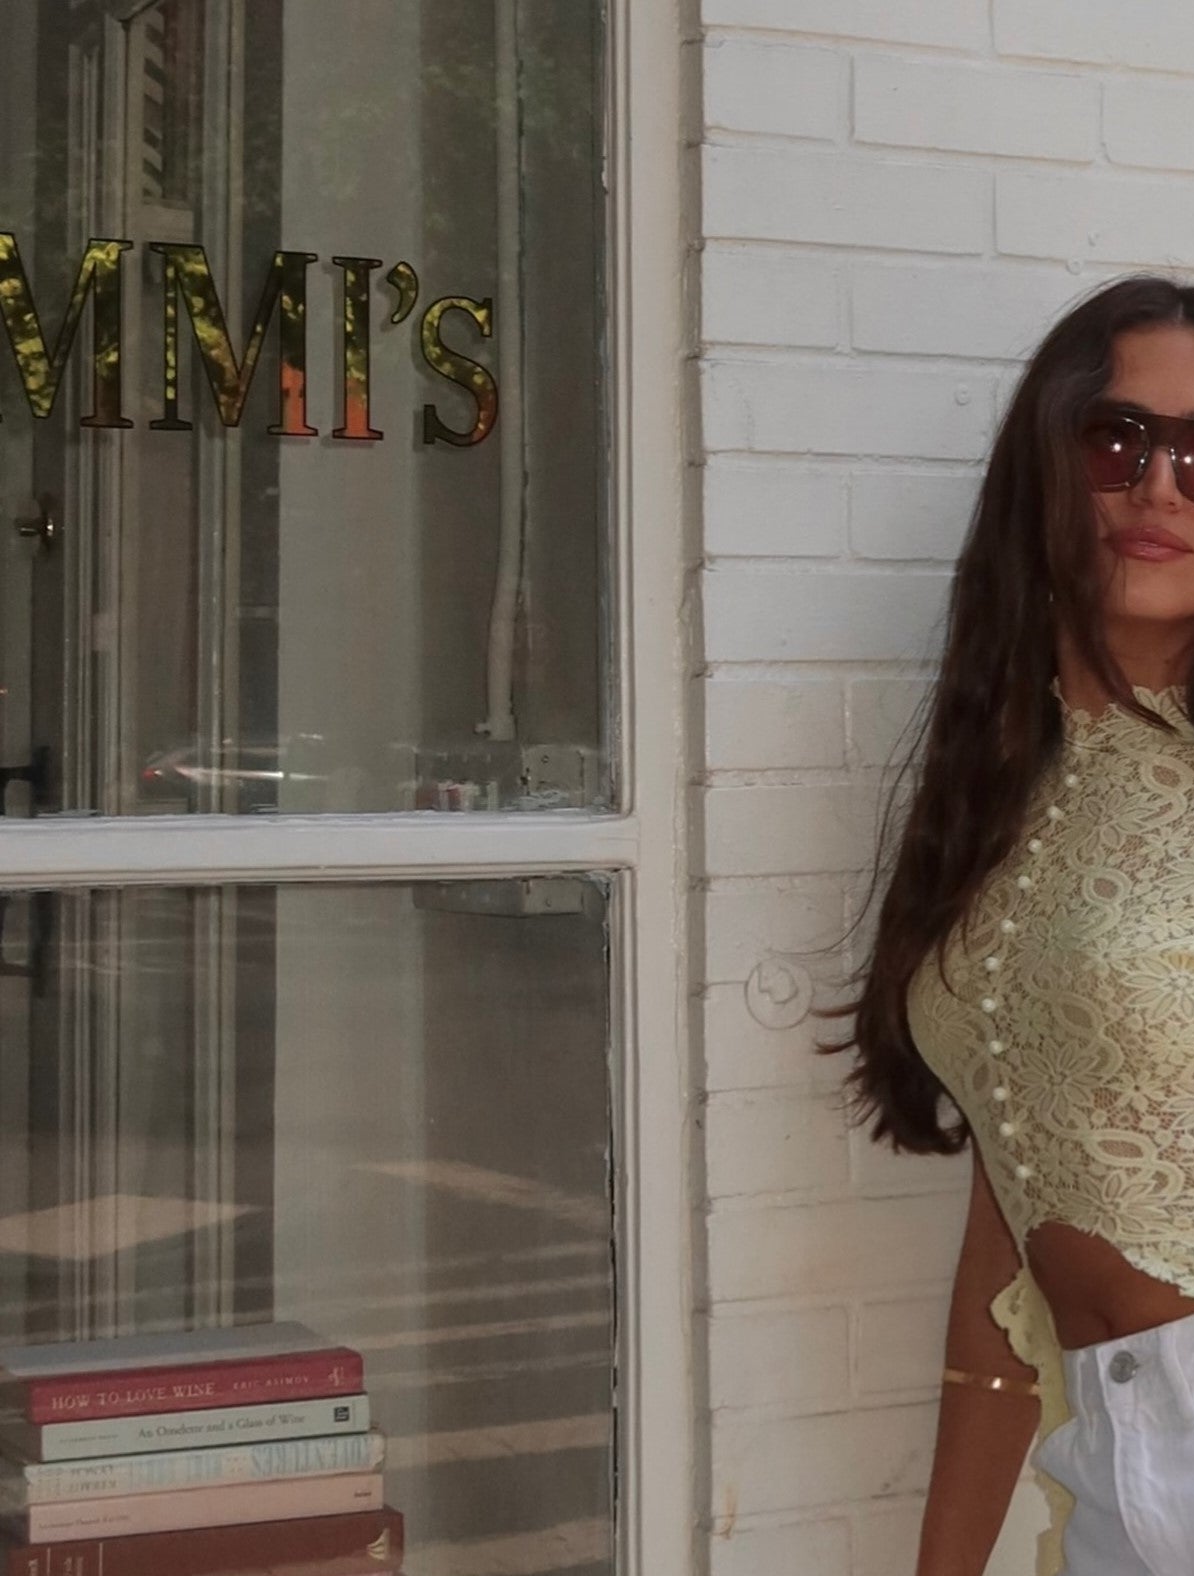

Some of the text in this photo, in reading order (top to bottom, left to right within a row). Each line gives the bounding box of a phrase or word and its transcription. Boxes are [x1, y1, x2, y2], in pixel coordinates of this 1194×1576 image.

[51, 1382, 216, 1410] HOW TO LOVE WINE
[233, 1376, 309, 1390] ERIC ASIMOV
[138, 1428, 153, 1439] An
[206, 1419, 226, 1433] and
[235, 1414, 263, 1430] Glass
[265, 1413, 277, 1426] of
[278, 1411, 306, 1426] Wine
